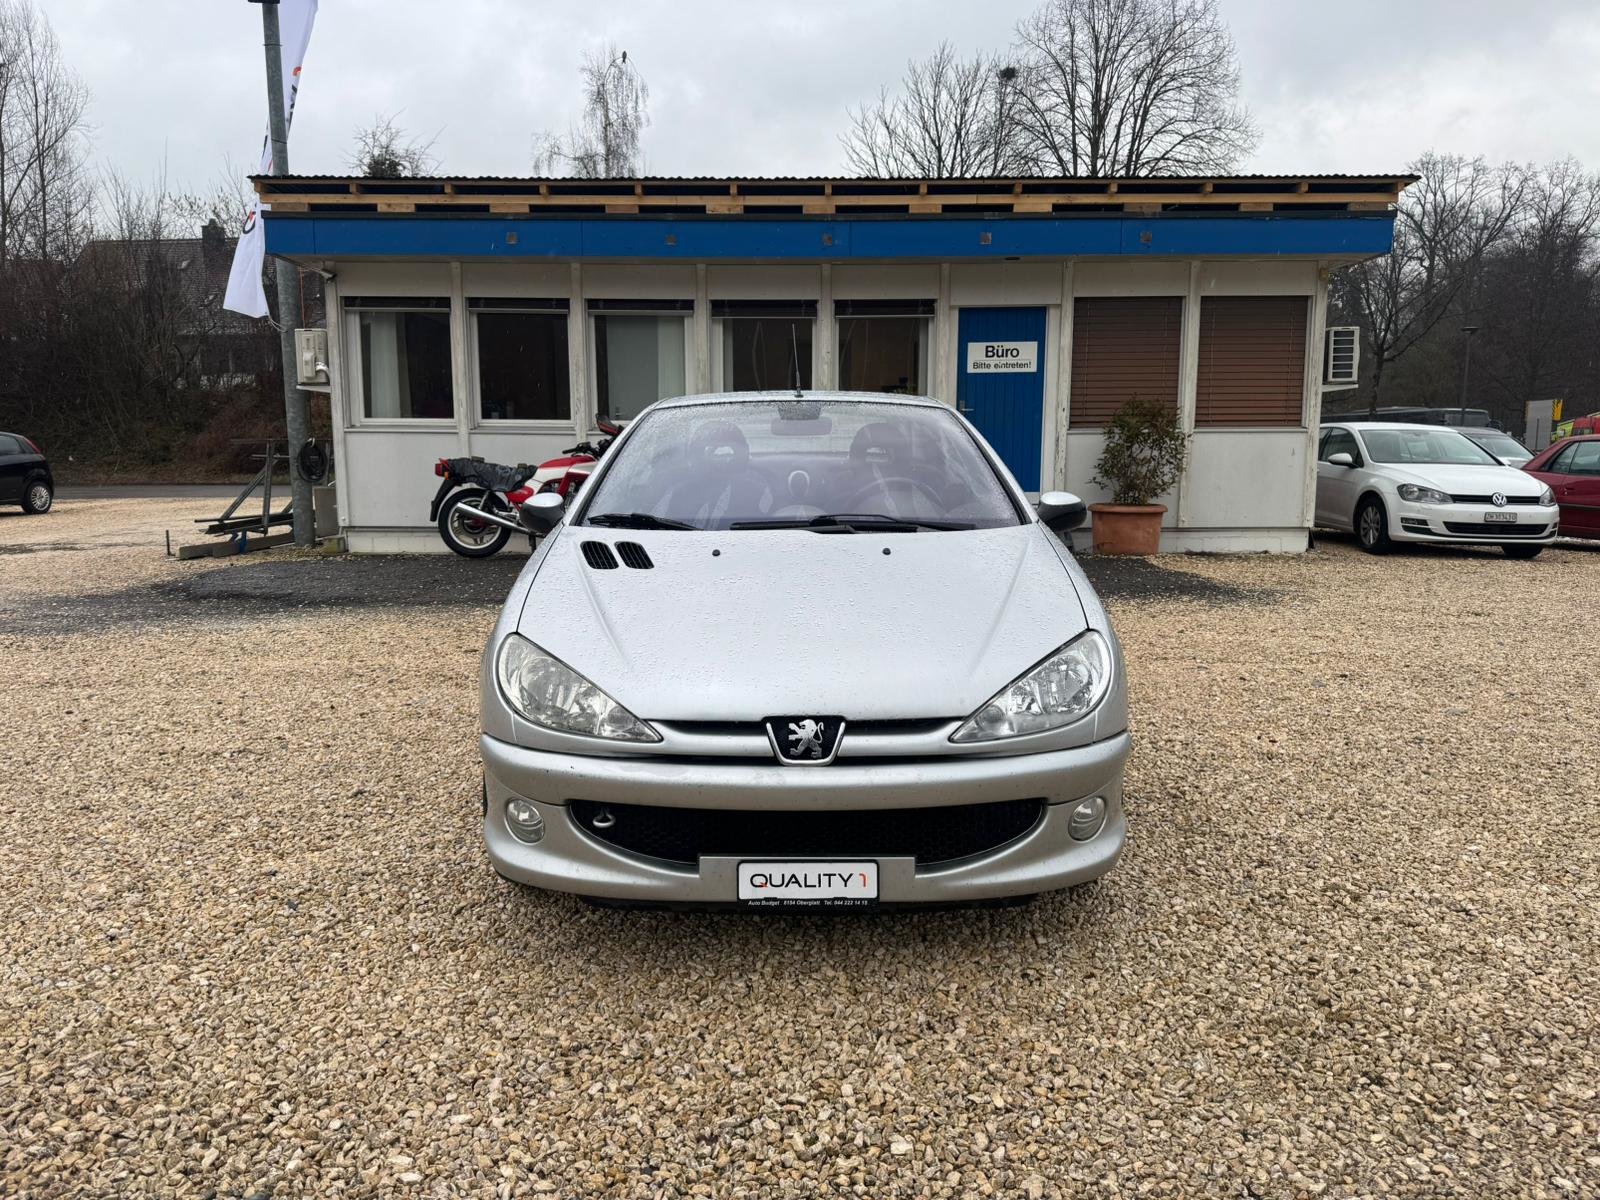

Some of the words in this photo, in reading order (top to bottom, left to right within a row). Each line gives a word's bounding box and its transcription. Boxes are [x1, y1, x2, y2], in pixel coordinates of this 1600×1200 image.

[985, 345, 1020, 358] Büro
[972, 361, 991, 370] Bitte
[993, 361, 1032, 370] eintreten!
[749, 873, 854, 888] QUALITY
[858, 872, 868, 888] 1
